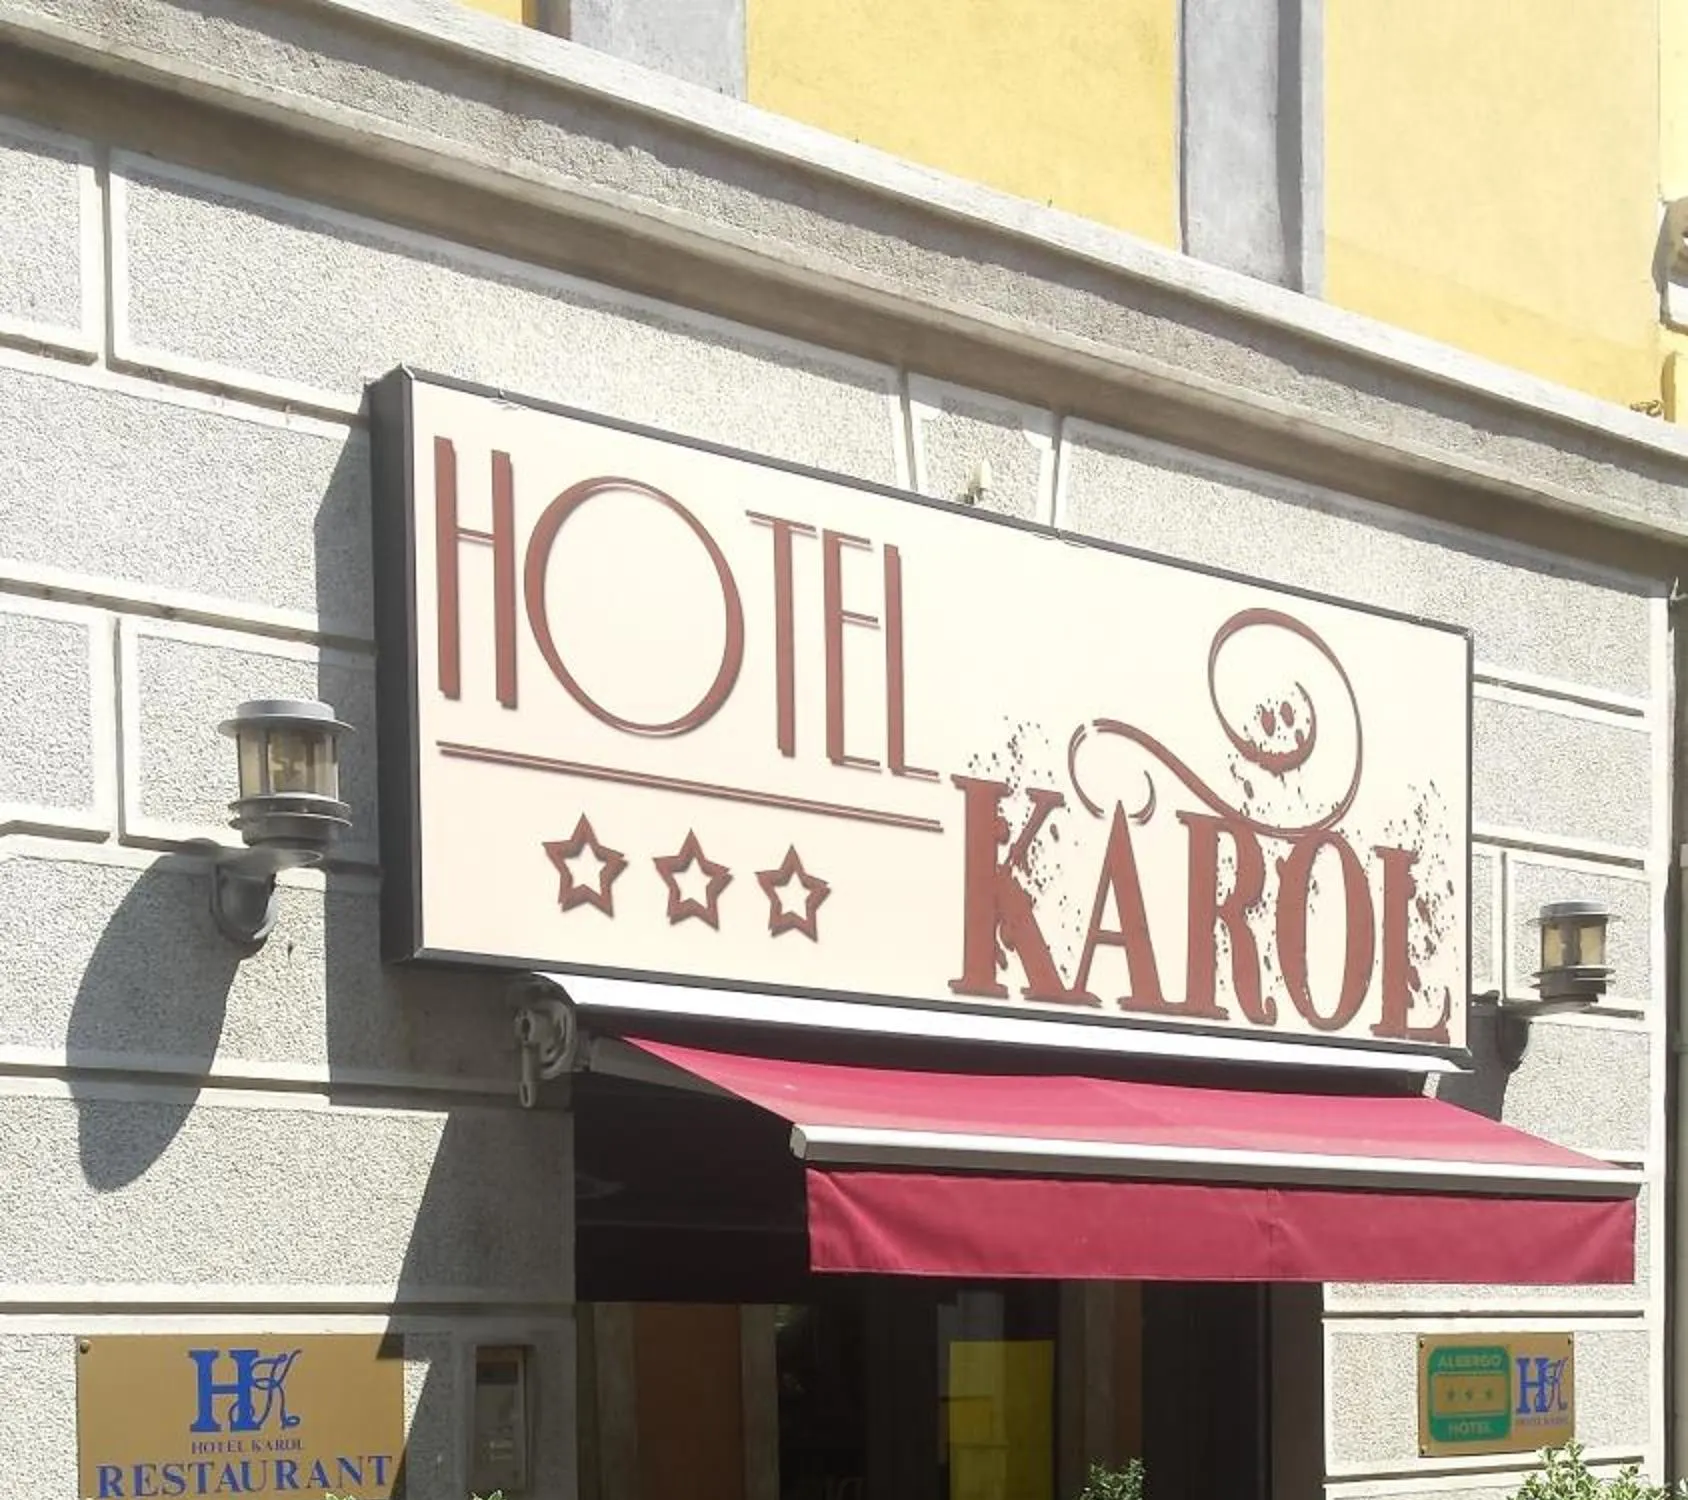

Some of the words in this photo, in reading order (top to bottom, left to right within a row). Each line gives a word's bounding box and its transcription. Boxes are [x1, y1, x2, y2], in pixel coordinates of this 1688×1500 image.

[433, 436, 941, 783] HOTEL
[948, 772, 1451, 1044] KAROL
[1438, 1354, 1502, 1368] ALBERGO
[1448, 1420, 1494, 1435] HOTEL
[191, 1440, 244, 1454] HOTEL
[251, 1438, 304, 1452] KAROL
[95, 1455, 392, 1499] RESTAURANT
